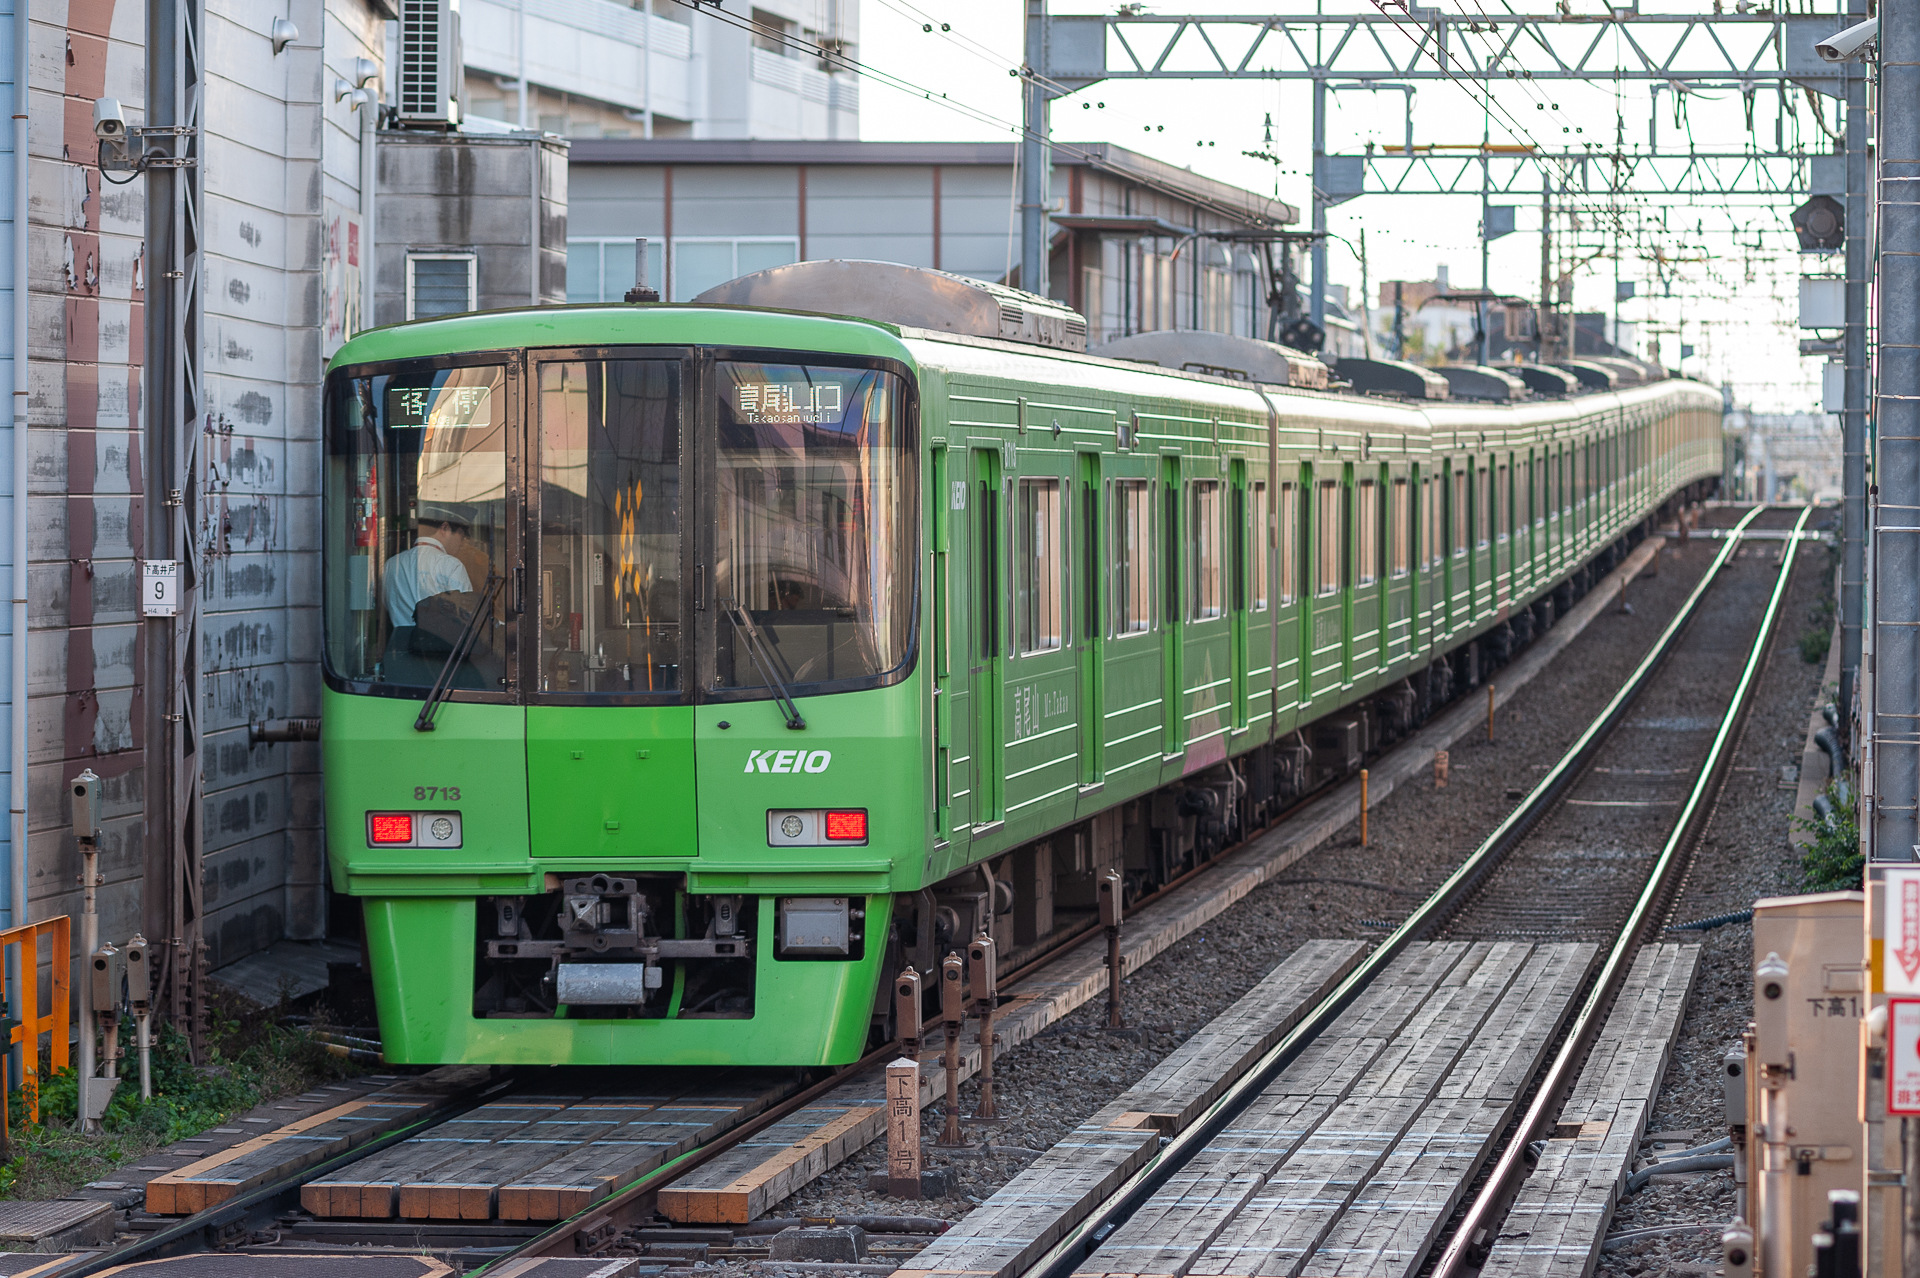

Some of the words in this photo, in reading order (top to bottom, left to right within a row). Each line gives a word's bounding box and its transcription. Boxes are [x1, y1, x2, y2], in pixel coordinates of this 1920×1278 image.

[951, 480, 966, 510] KEIO
[144, 564, 176, 576] 下高井戸
[154, 581, 165, 600] 9
[743, 749, 832, 774] KEIO
[413, 785, 462, 801] 8713
[1806, 996, 1864, 1018] 下高1
[890, 1074, 915, 1171] 下高1号
